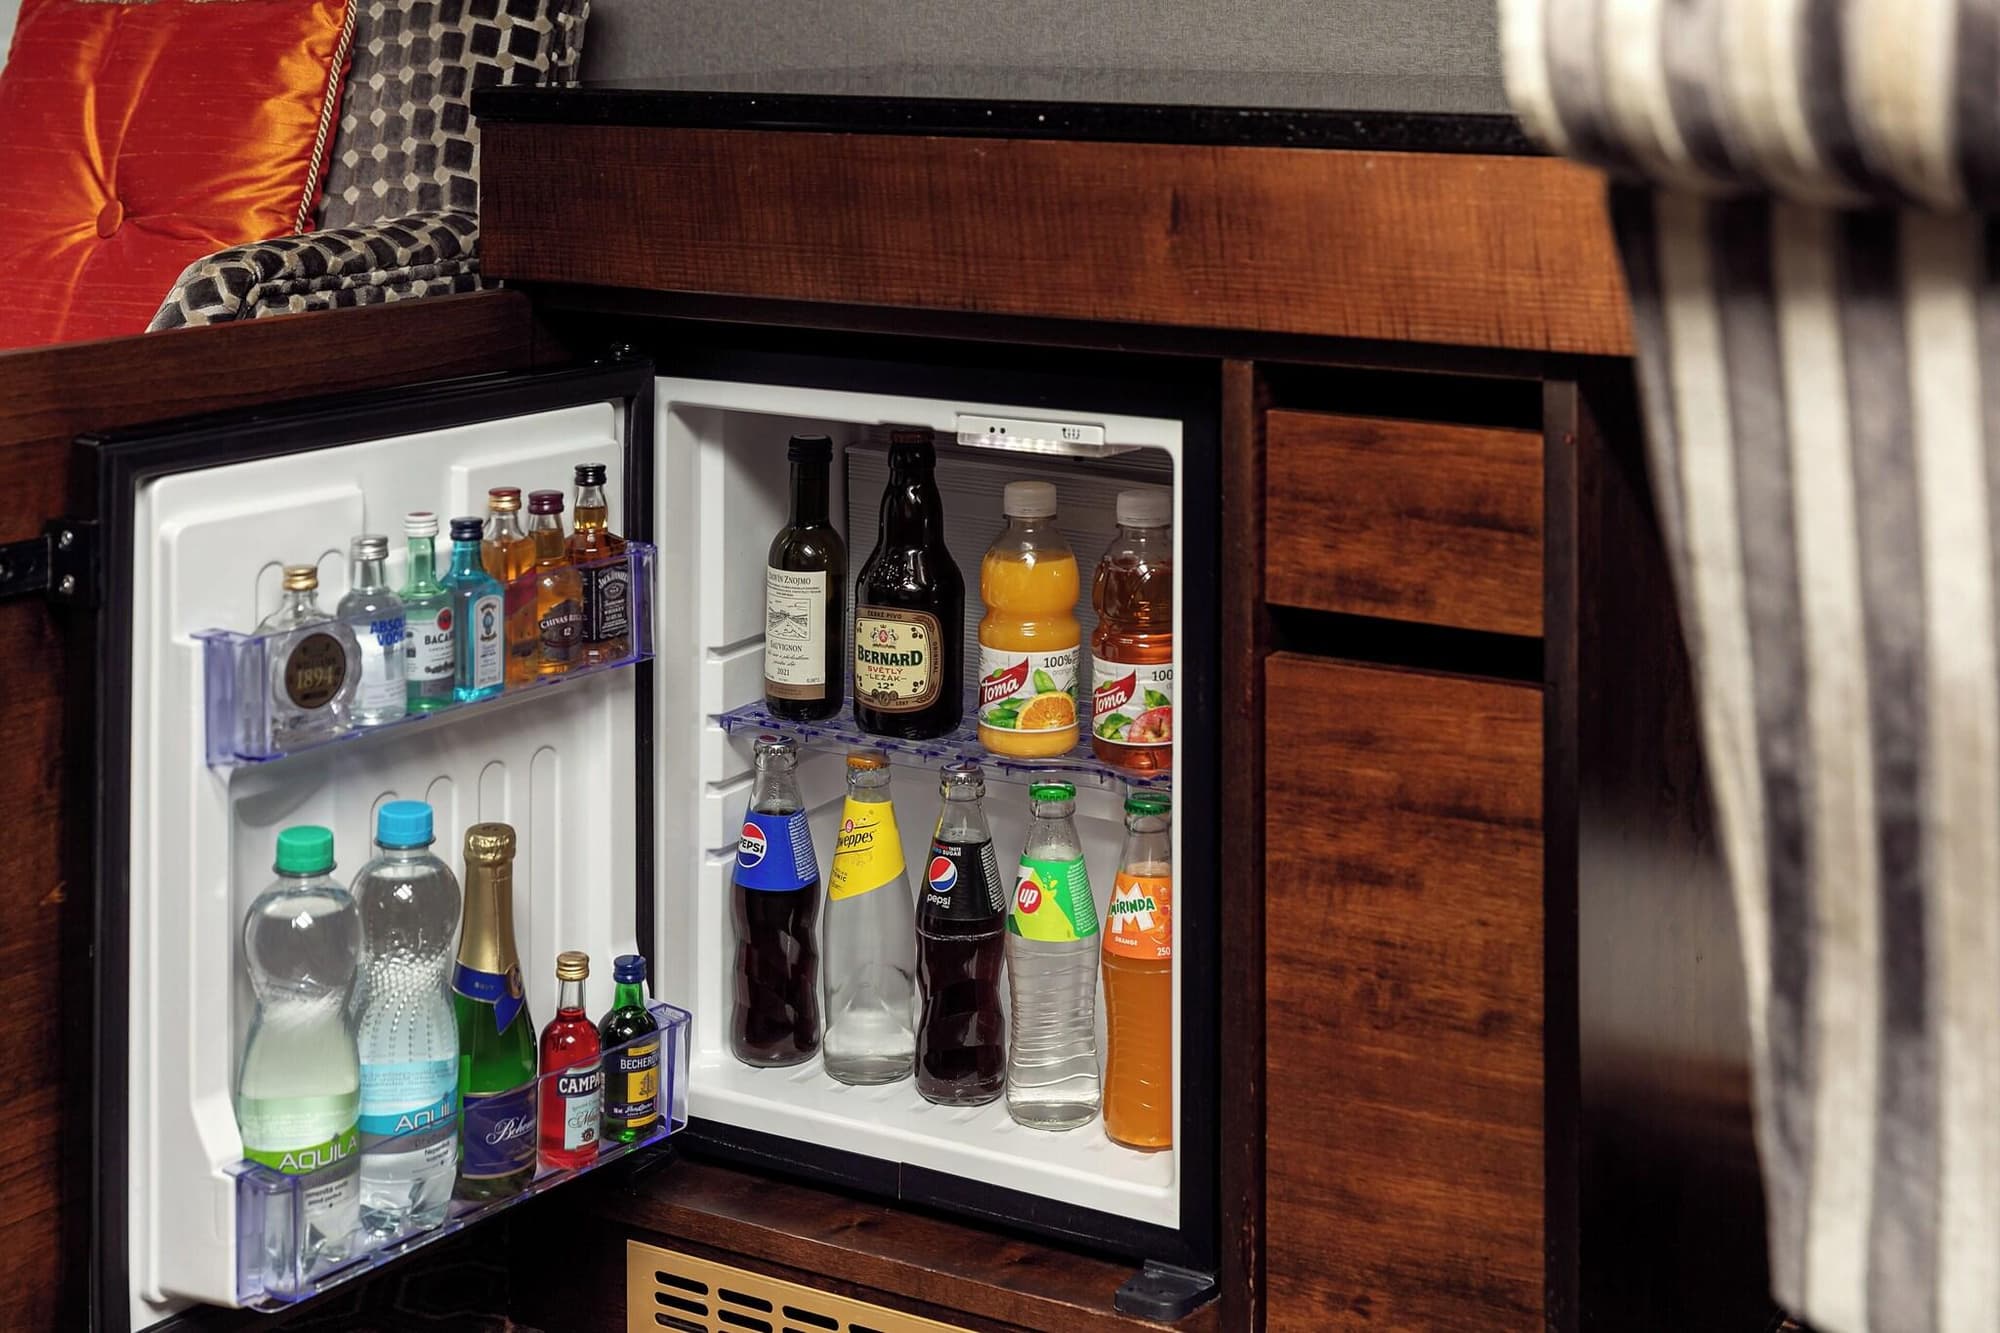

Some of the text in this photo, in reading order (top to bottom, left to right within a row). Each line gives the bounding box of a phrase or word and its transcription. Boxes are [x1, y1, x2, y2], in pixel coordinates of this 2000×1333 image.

[784, 575, 811, 586] ZNOJMO
[540, 615, 568, 629] CHIVAS
[857, 643, 923, 667] BERNARD
[1043, 654, 1073, 669] 100%
[296, 665, 333, 690] 1894
[983, 674, 1019, 703] Toma
[1094, 685, 1128, 715] Toma
[926, 893, 951, 907] pepsi
[1156, 947, 1171, 956] 250
[559, 1071, 601, 1094] CAMPA
[278, 1135, 357, 1171] AQUILA
